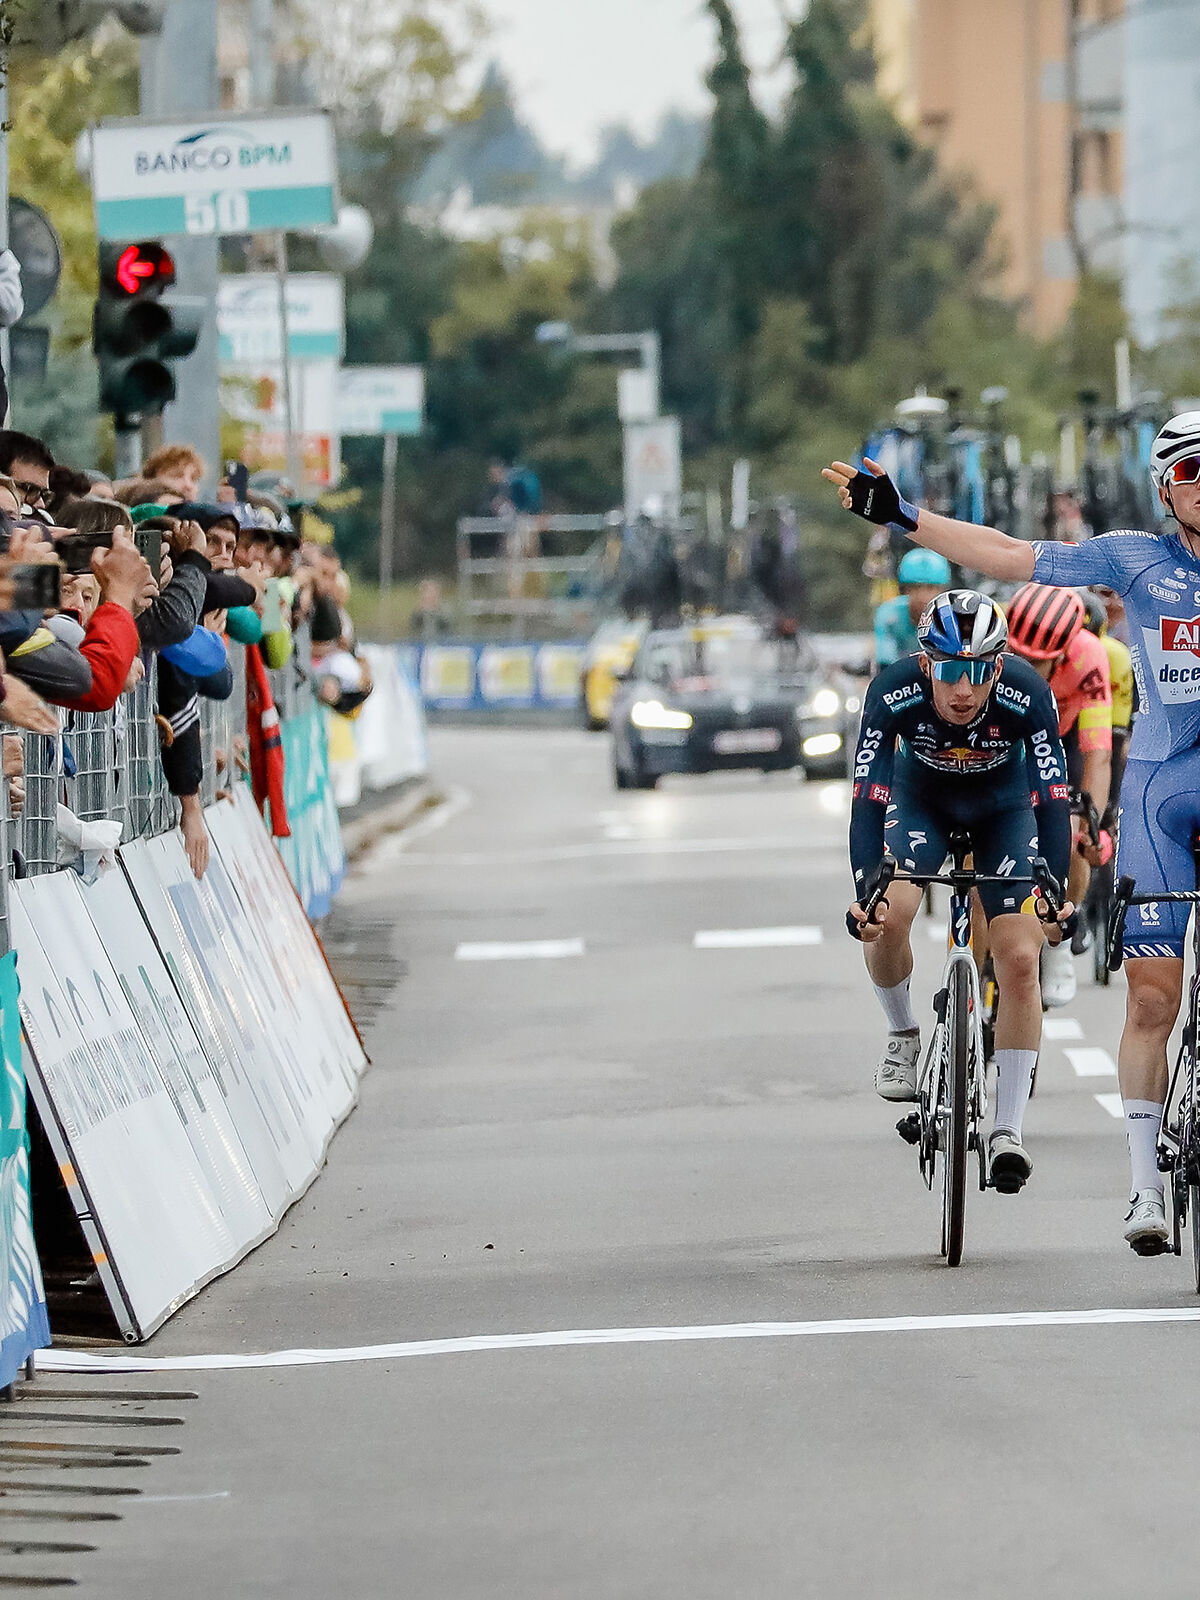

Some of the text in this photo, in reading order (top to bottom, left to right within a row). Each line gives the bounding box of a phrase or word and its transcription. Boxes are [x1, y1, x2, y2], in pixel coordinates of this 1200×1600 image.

[135, 143, 291, 175] BANCO BPM
[184, 189, 249, 235] 50
[882, 682, 923, 706] BORA
[996, 682, 1031, 708] BORA
[855, 727, 883, 778] BOSS
[981, 740, 1012, 748] BOSS
[1031, 729, 1061, 780] BOSS
